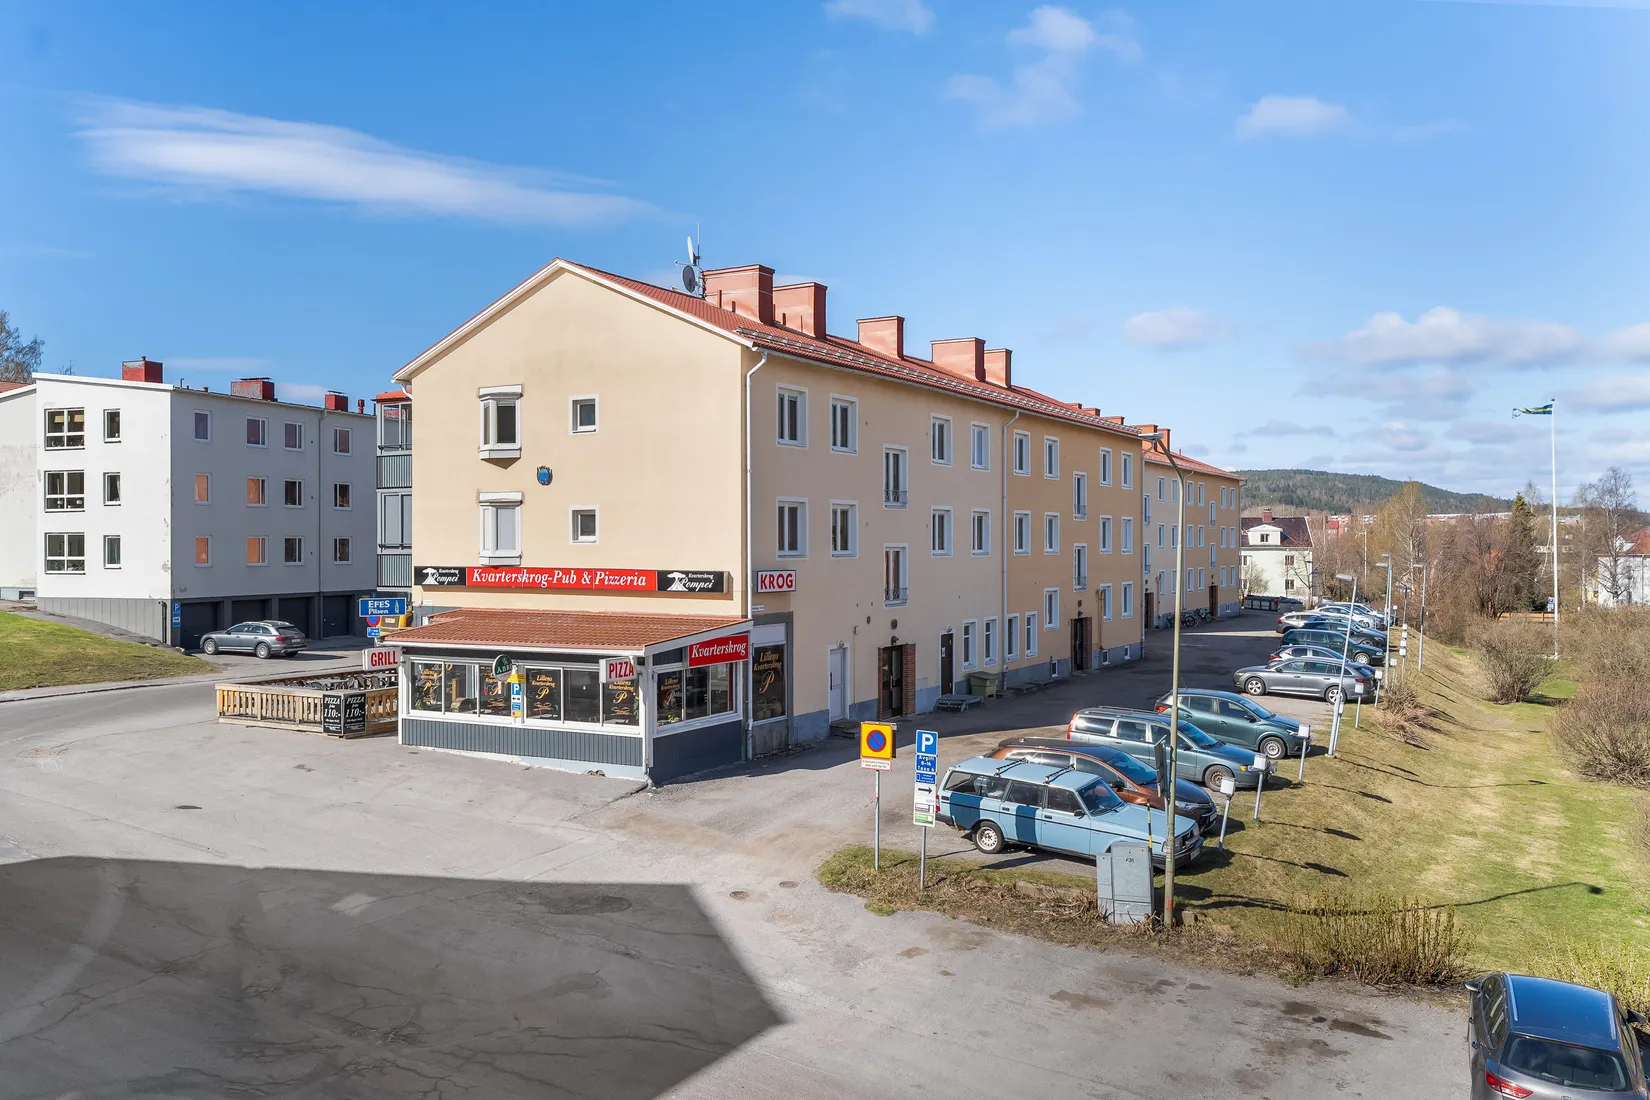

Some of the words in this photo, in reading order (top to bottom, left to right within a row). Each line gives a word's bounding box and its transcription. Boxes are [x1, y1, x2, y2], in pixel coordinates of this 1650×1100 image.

[433, 572, 460, 585] Pompei
[472, 568, 577, 588] Kvarterskrog-Pub
[581, 572, 592, 585] &
[594, 572, 646, 586] Pizzeria
[681, 577, 714, 592] Pompei
[760, 573, 793, 590] KROG
[692, 640, 746, 658] Kvarterskrog
[760, 652, 778, 661] Lillens
[371, 651, 398, 666] GRILL
[609, 661, 634, 679] PIZZA
[514, 684, 519, 694] P
[759, 671, 774, 693] P
[324, 709, 340, 717] 110:-
[346, 708, 364, 717] 110:-
[922, 734, 933, 752] P
